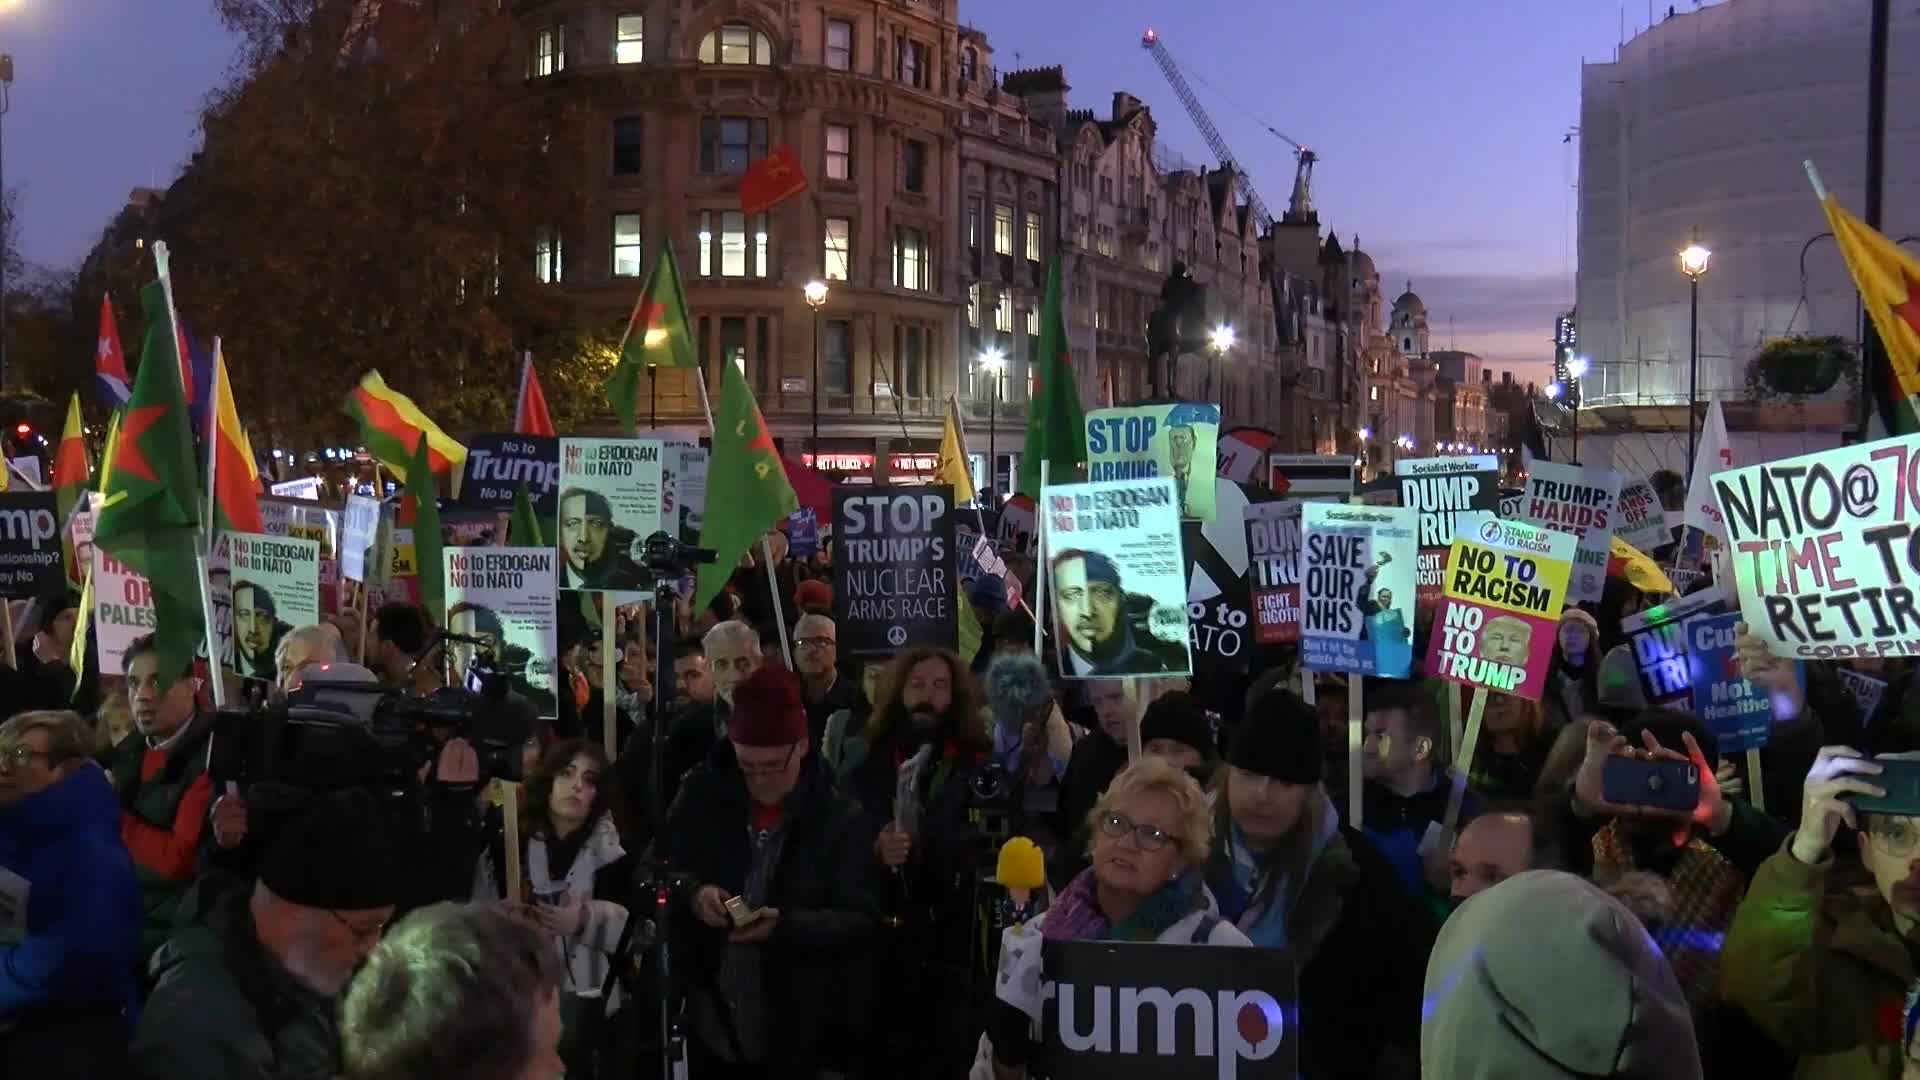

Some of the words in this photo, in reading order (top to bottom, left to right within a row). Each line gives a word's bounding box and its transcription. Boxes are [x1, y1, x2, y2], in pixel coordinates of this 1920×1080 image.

[502, 441, 519, 453] No
[522, 443, 536, 454] to
[1087, 416, 1157, 454] STOP
[565, 444, 582, 458] No
[599, 445, 658, 462] ERDOGAN
[565, 458, 581, 474] No
[585, 461, 596, 475] to
[598, 461, 632, 476] NATO
[1091, 459, 1158, 483] ARMING
[1412, 463, 1448, 474] Socialist
[1448, 461, 1479, 472] Worker
[480, 487, 497, 499] No
[500, 488, 513, 499] to
[1094, 485, 1169, 510] ERDOGAN
[1402, 475, 1480, 512] DUMP
[1532, 478, 1613, 509] TRUMP:
[842, 494, 945, 534] STOP
[1095, 509, 1140, 530] NATO
[1529, 497, 1609, 529] HANDS
[1503, 535, 1515, 545] TO
[1516, 538, 1551, 553] RACISM
[1504, 526, 1535, 540] STAND
[1535, 533, 1549, 543] UP
[234, 537, 249, 554] No
[251, 541, 262, 556] to
[262, 541, 314, 562] ERDOGAN
[844, 536, 945, 564] TRUMP'S
[1308, 533, 1365, 569] SAVE
[234, 553, 249, 570] No
[251, 555, 262, 571] to
[262, 558, 293, 575] NATO
[449, 554, 468, 571] No
[471, 555, 484, 571] to
[486, 554, 550, 571] ERDOGAN
[1458, 545, 1496, 574] NO
[1503, 554, 1536, 583] TO
[1737, 531, 1858, 597] TIME
[16, 569, 34, 582] No
[450, 571, 468, 588] No
[471, 572, 484, 588] to
[486, 572, 523, 588] NATO
[847, 567, 946, 597] NUCLEAR
[1306, 568, 1353, 601] OUR
[1257, 592, 1291, 611] FIGHT
[1453, 571, 1551, 612] RACISM
[848, 598, 897, 620] ARMS
[902, 597, 945, 619] RACE
[1216, 602, 1247, 628] to
[1305, 599, 1352, 633] NHS
[1445, 601, 1484, 632] NO
[1188, 623, 1241, 656] ATO
[1442, 625, 1476, 655] TO
[1437, 649, 1527, 691] TRUMP
[1711, 679, 1753, 704] Not
